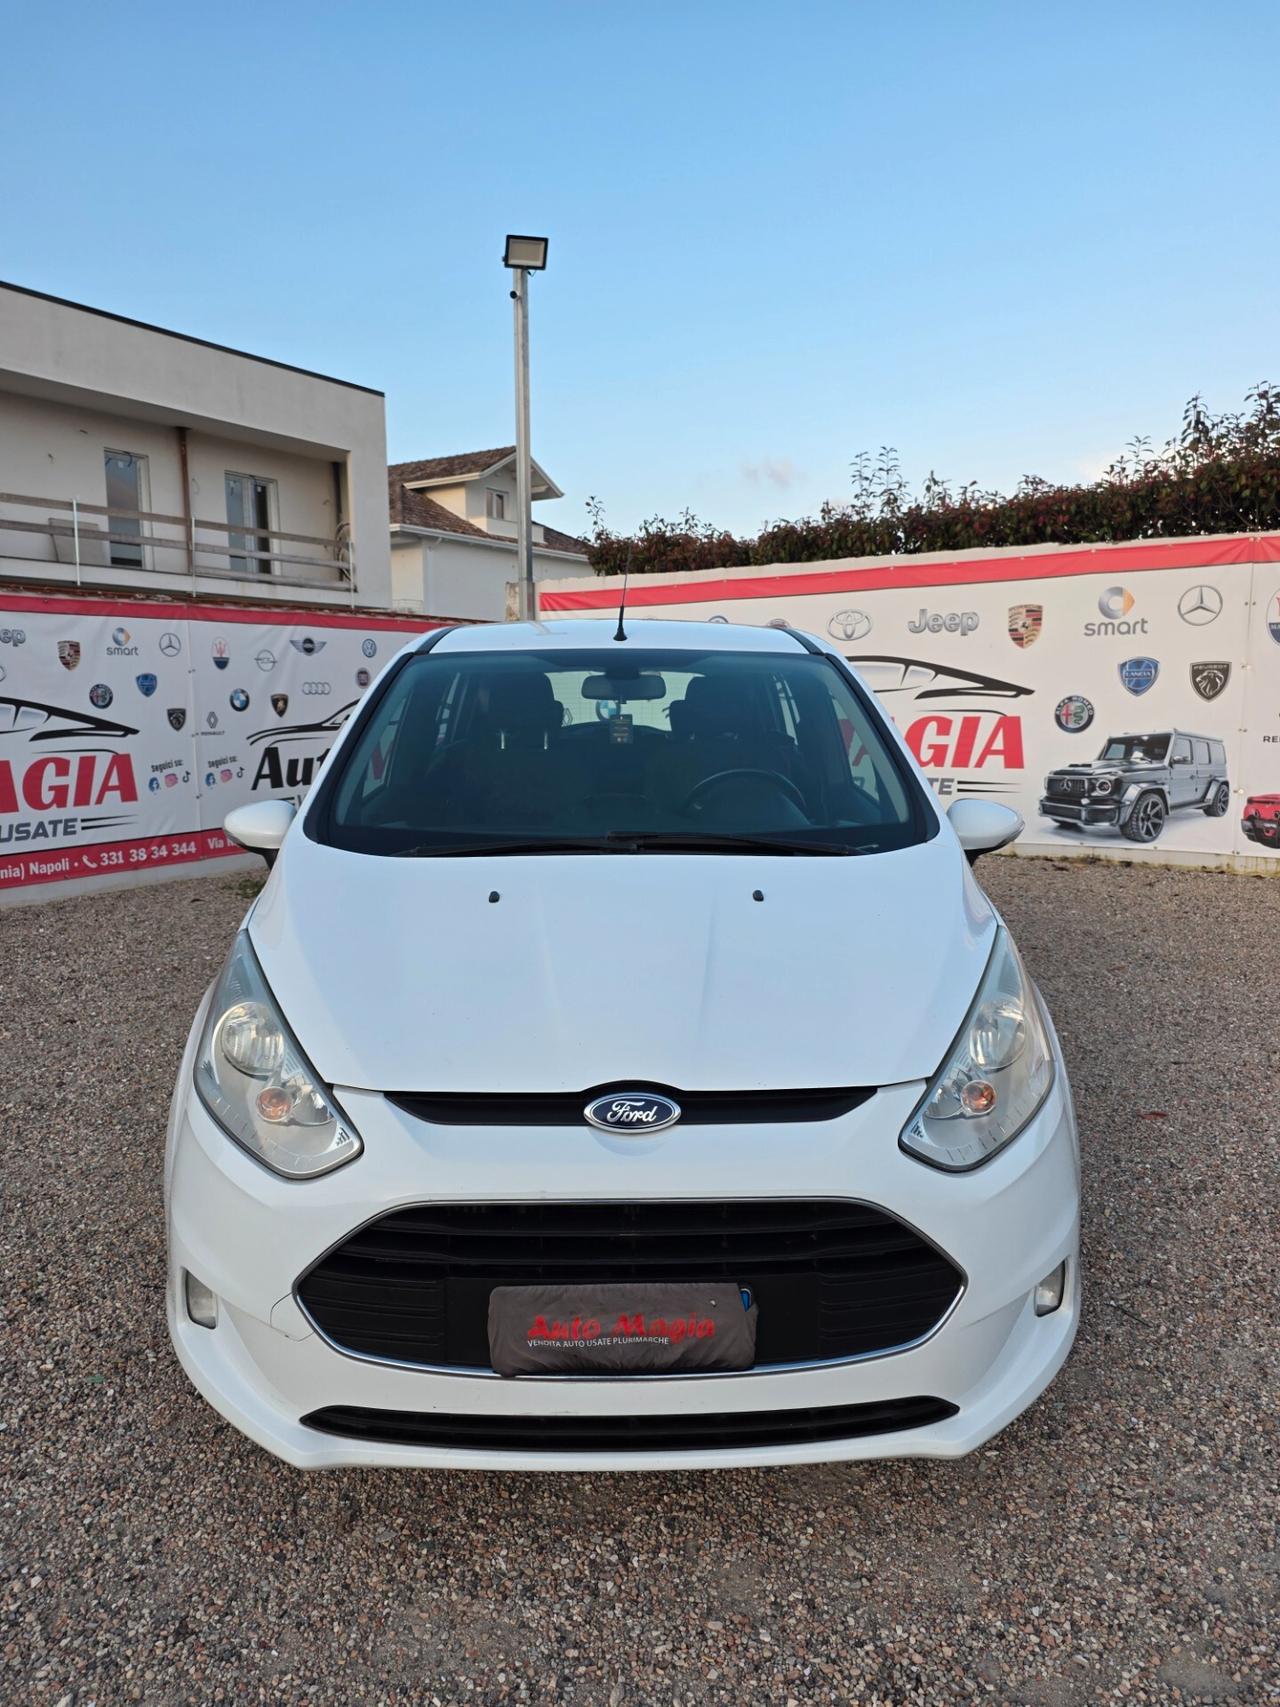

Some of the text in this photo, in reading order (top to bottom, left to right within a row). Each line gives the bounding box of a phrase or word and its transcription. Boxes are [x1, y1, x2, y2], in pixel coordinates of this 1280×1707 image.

[908, 608, 979, 635] Jeep
[1084, 618, 1148, 636] smart
[106, 646, 139, 656] smart
[151, 761, 174, 774] Seguici
[208, 757, 229, 769] Seguici
[207, 838, 225, 850] Via
[29, 858, 70, 876] Napoli
[100, 851, 125, 866] 331
[129, 847, 148, 862] 38
[151, 845, 168, 859] 34
[171, 841, 197, 856] 344
[606, 1100, 658, 1123] Ford
[527, 1315, 601, 1339] Auto
[527, 1336, 669, 1348] VENDITA AUTO USATE PLURIMARCHE
